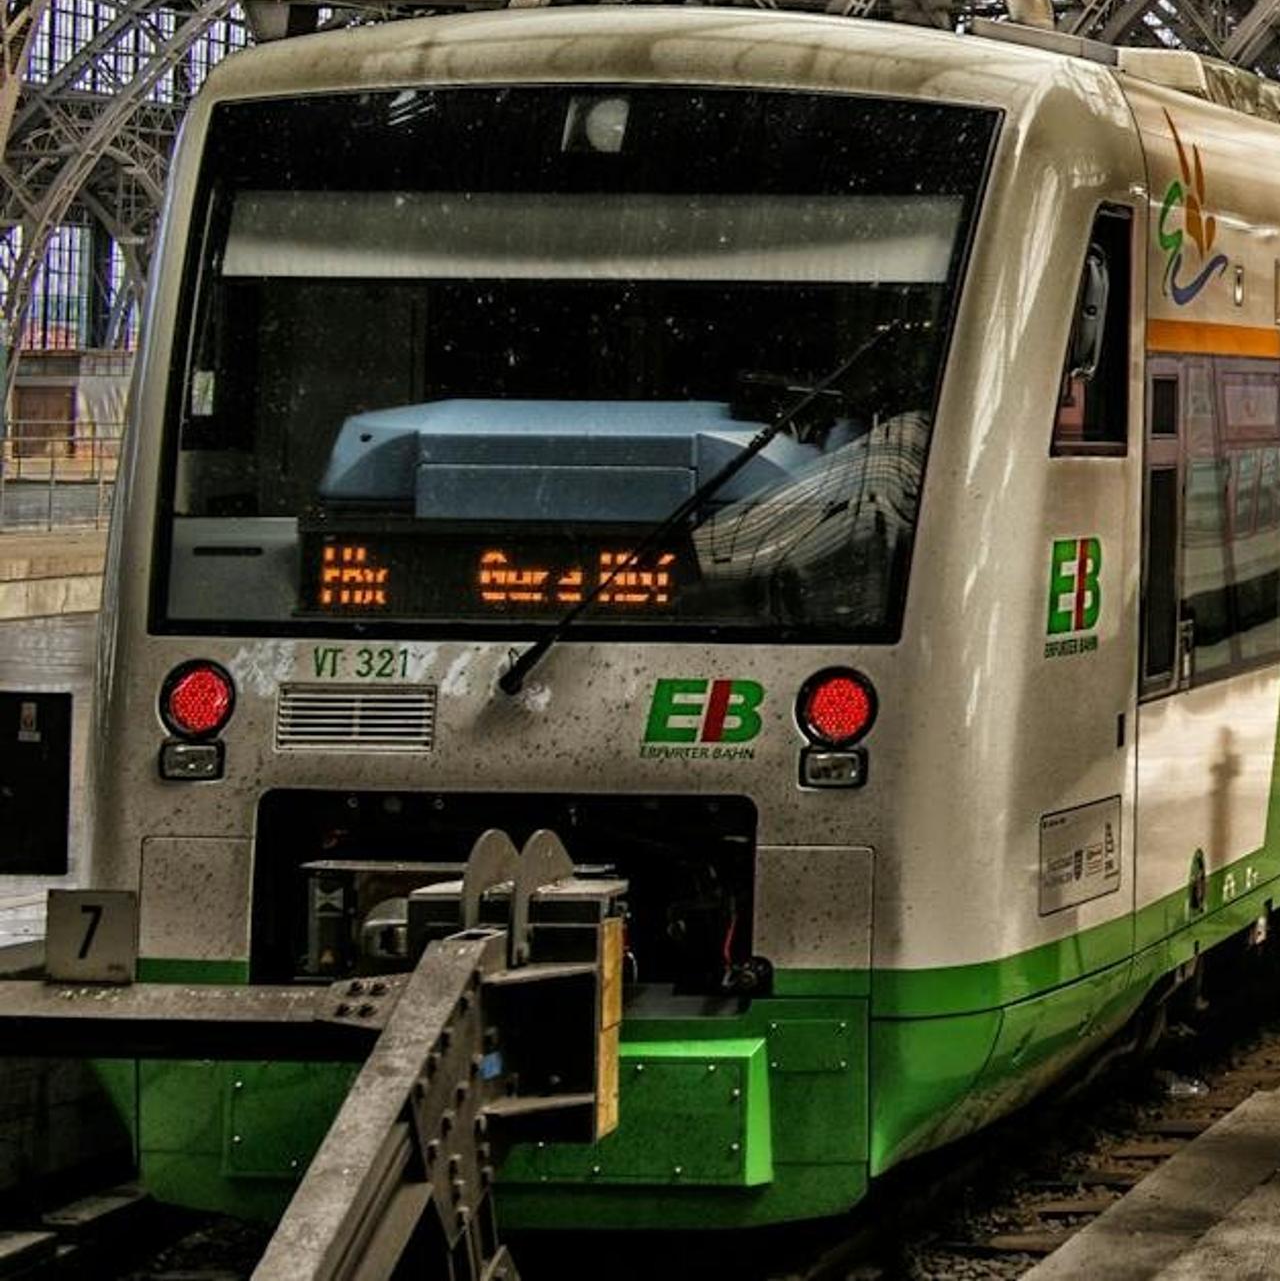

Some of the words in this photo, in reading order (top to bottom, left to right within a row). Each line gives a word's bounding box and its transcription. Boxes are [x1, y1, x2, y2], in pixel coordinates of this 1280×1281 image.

[313, 648, 342, 678] VT
[356, 648, 408, 678] 321
[713, 746, 755, 759] BAHN
[78, 904, 103, 960] 7
